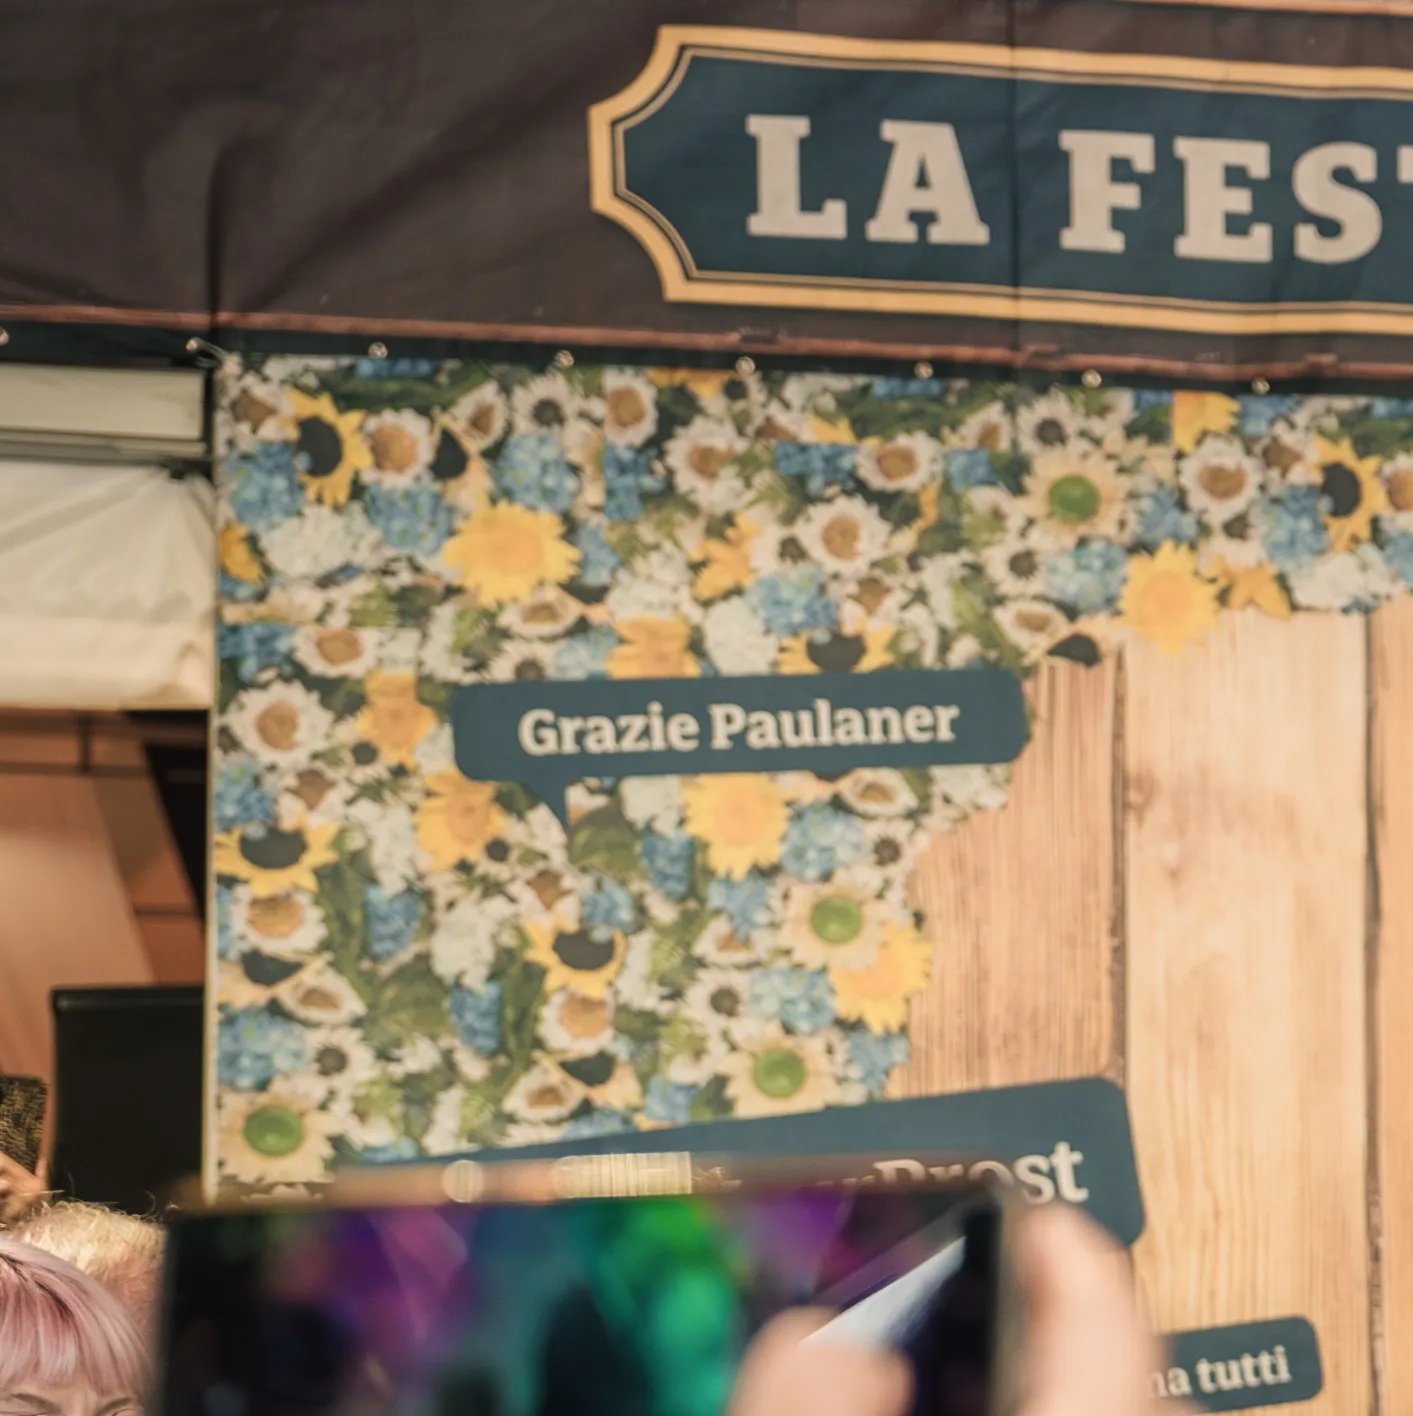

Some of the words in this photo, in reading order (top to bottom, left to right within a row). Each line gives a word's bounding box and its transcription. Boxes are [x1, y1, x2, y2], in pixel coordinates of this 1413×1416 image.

[744, 112, 991, 246] LA
[518, 701, 700, 757] Grazie
[709, 699, 961, 750] Paulaner
[1196, 1344, 1293, 1394] tutti
